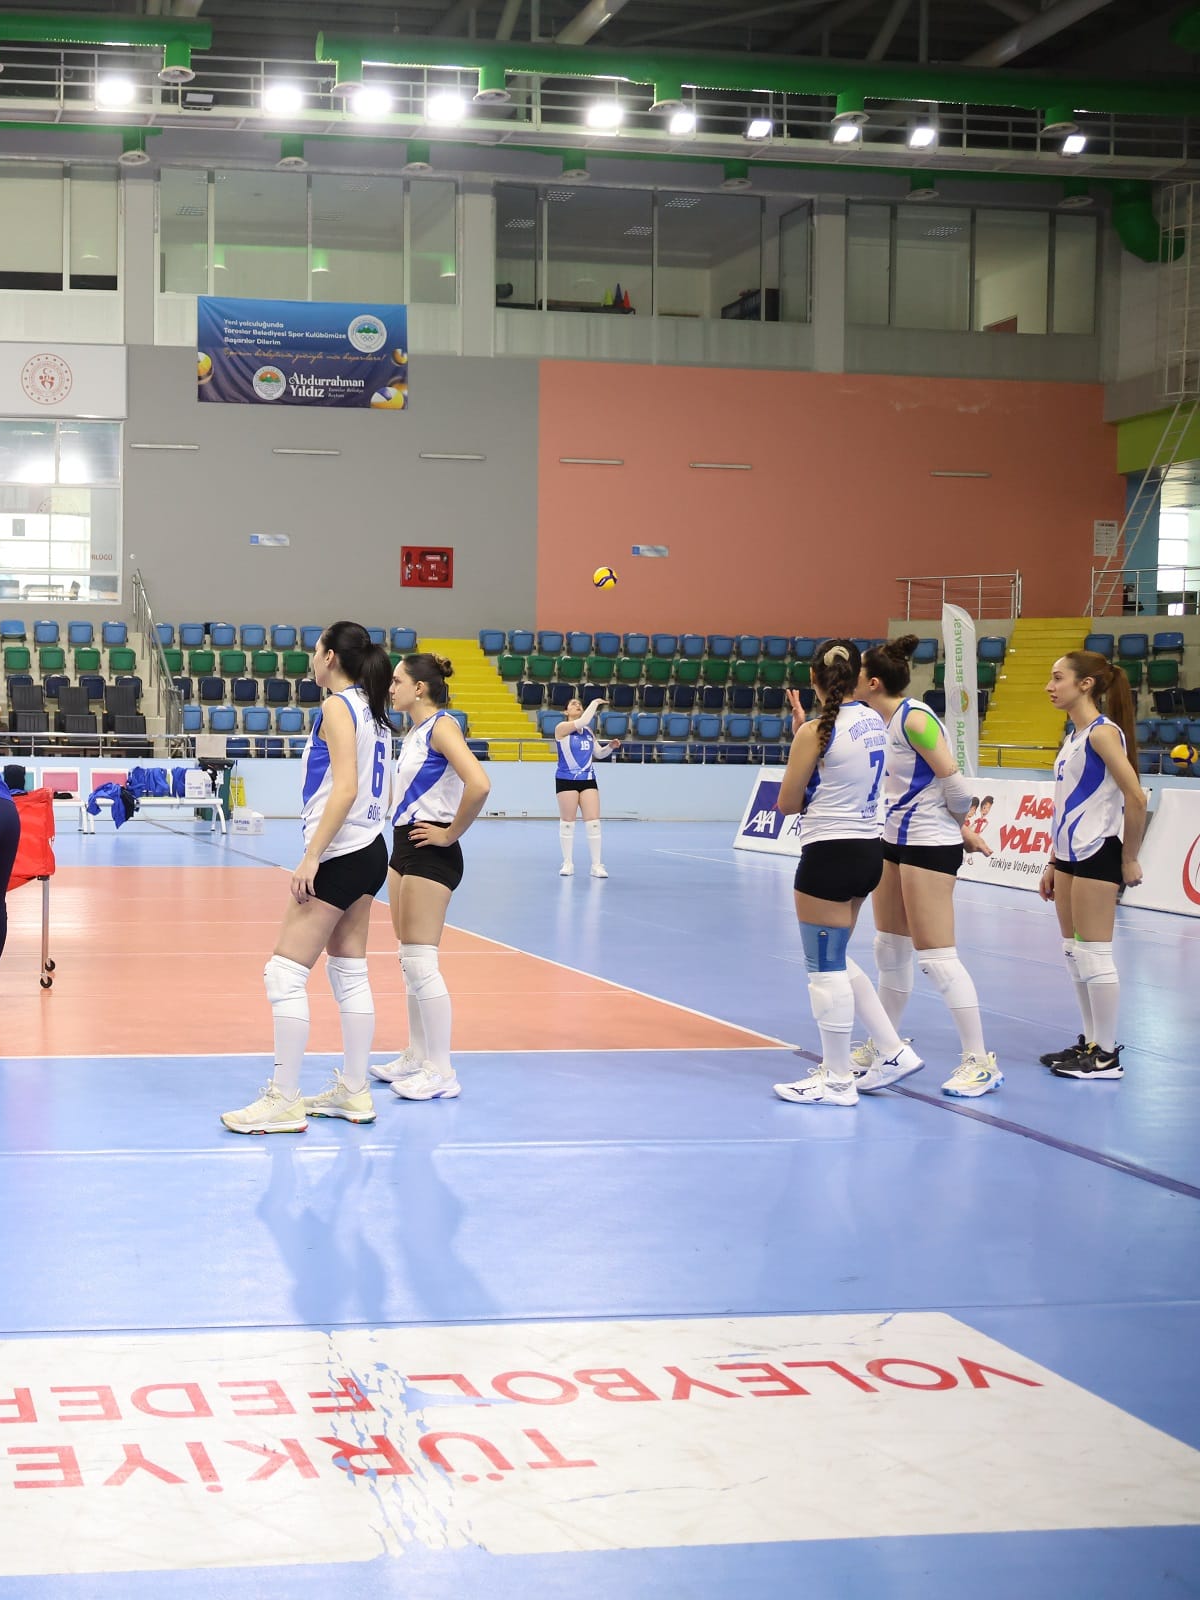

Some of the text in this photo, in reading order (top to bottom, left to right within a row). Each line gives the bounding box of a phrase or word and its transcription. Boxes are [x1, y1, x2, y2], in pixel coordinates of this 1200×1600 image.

[252, 328, 286, 337] Belediyesi
[305, 331, 346, 339] Kulübümüze
[288, 372, 365, 387] Abdurrahman
[290, 385, 325, 398] Yıldız
[372, 741, 385, 798] 6
[867, 750, 884, 802] 7
[745, 810, 776, 834] AXA
[989, 857, 1012, 871] Türkiye
[1012, 860, 1042, 875] Voleybol
[407, 1356, 1044, 1407] VOLEYBOL
[7, 1428, 598, 1494] TÜRKİYE
